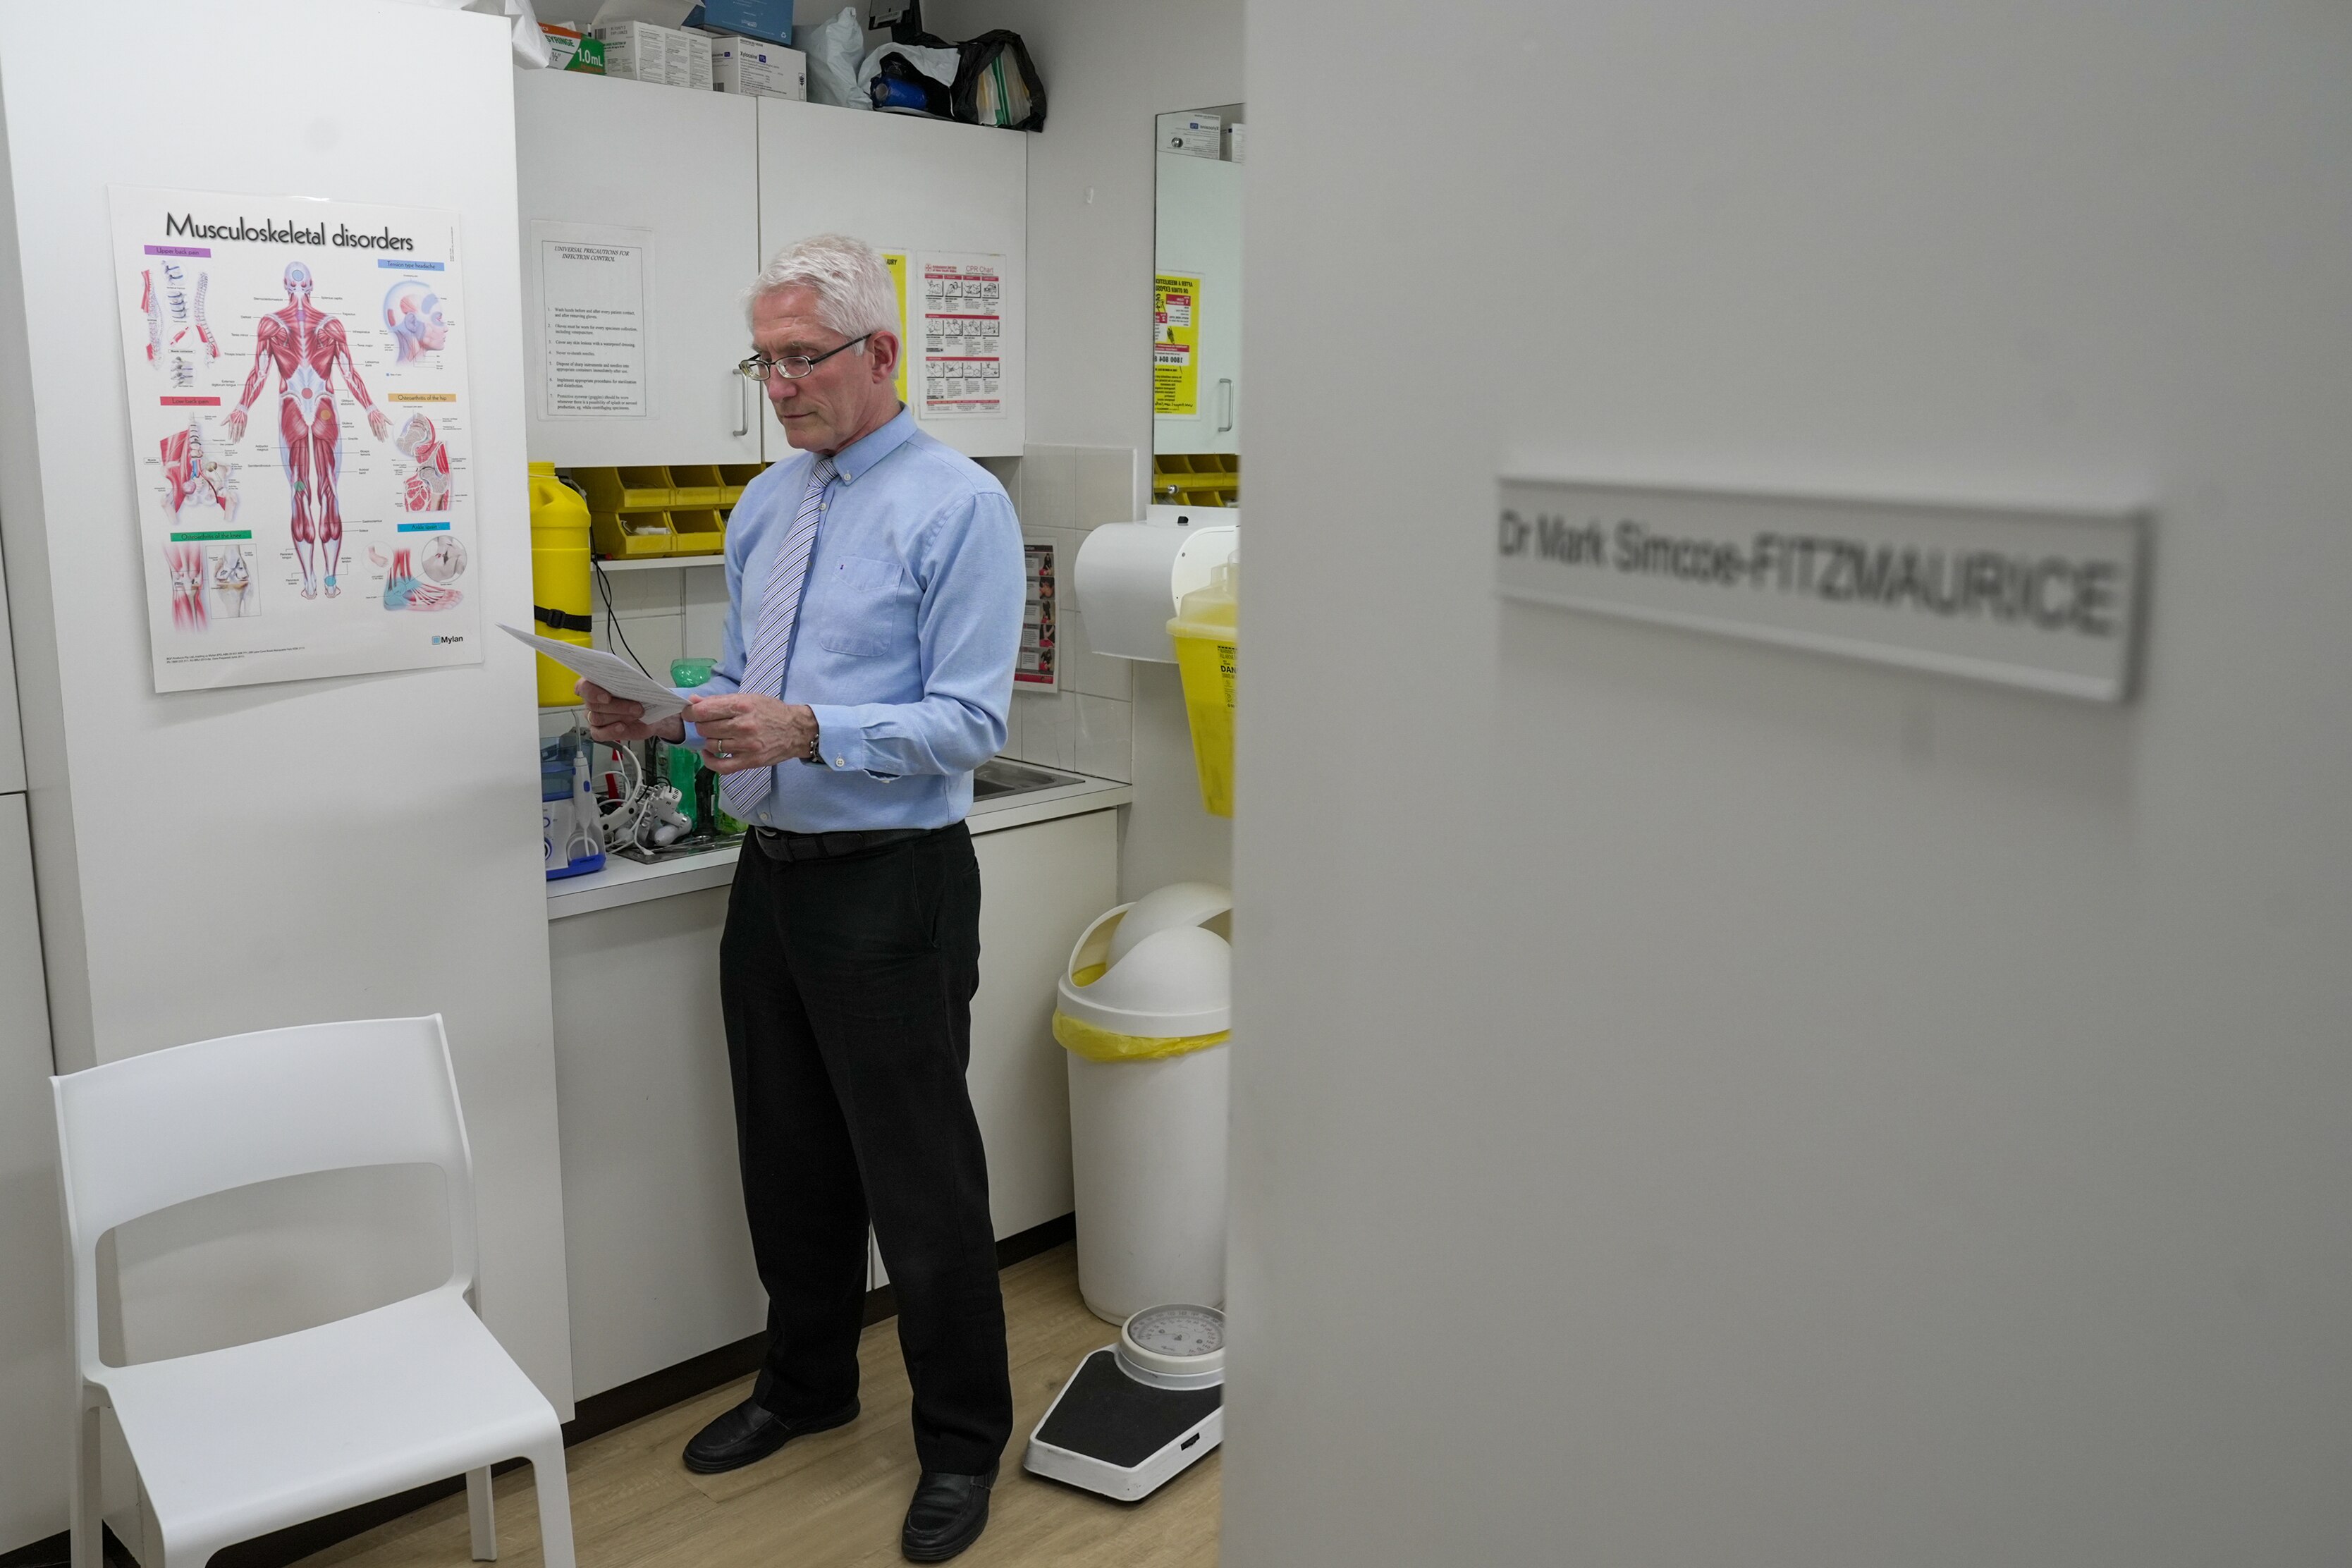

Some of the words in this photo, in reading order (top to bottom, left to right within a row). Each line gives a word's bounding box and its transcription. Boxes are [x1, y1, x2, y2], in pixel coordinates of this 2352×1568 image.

[546, 35, 575, 47] SYRINGE
[578, 48, 603, 66] 1.0mL
[166, 212, 326, 245] Musculoskeletal
[332, 223, 414, 251] disorders
[584, 247, 619, 256] PRECAUTIONS
[1499, 508, 1530, 556] Dr
[1536, 513, 1604, 565] Mark
[441, 636, 463, 644] Mylan
[1221, 665, 1237, 673] DAN
